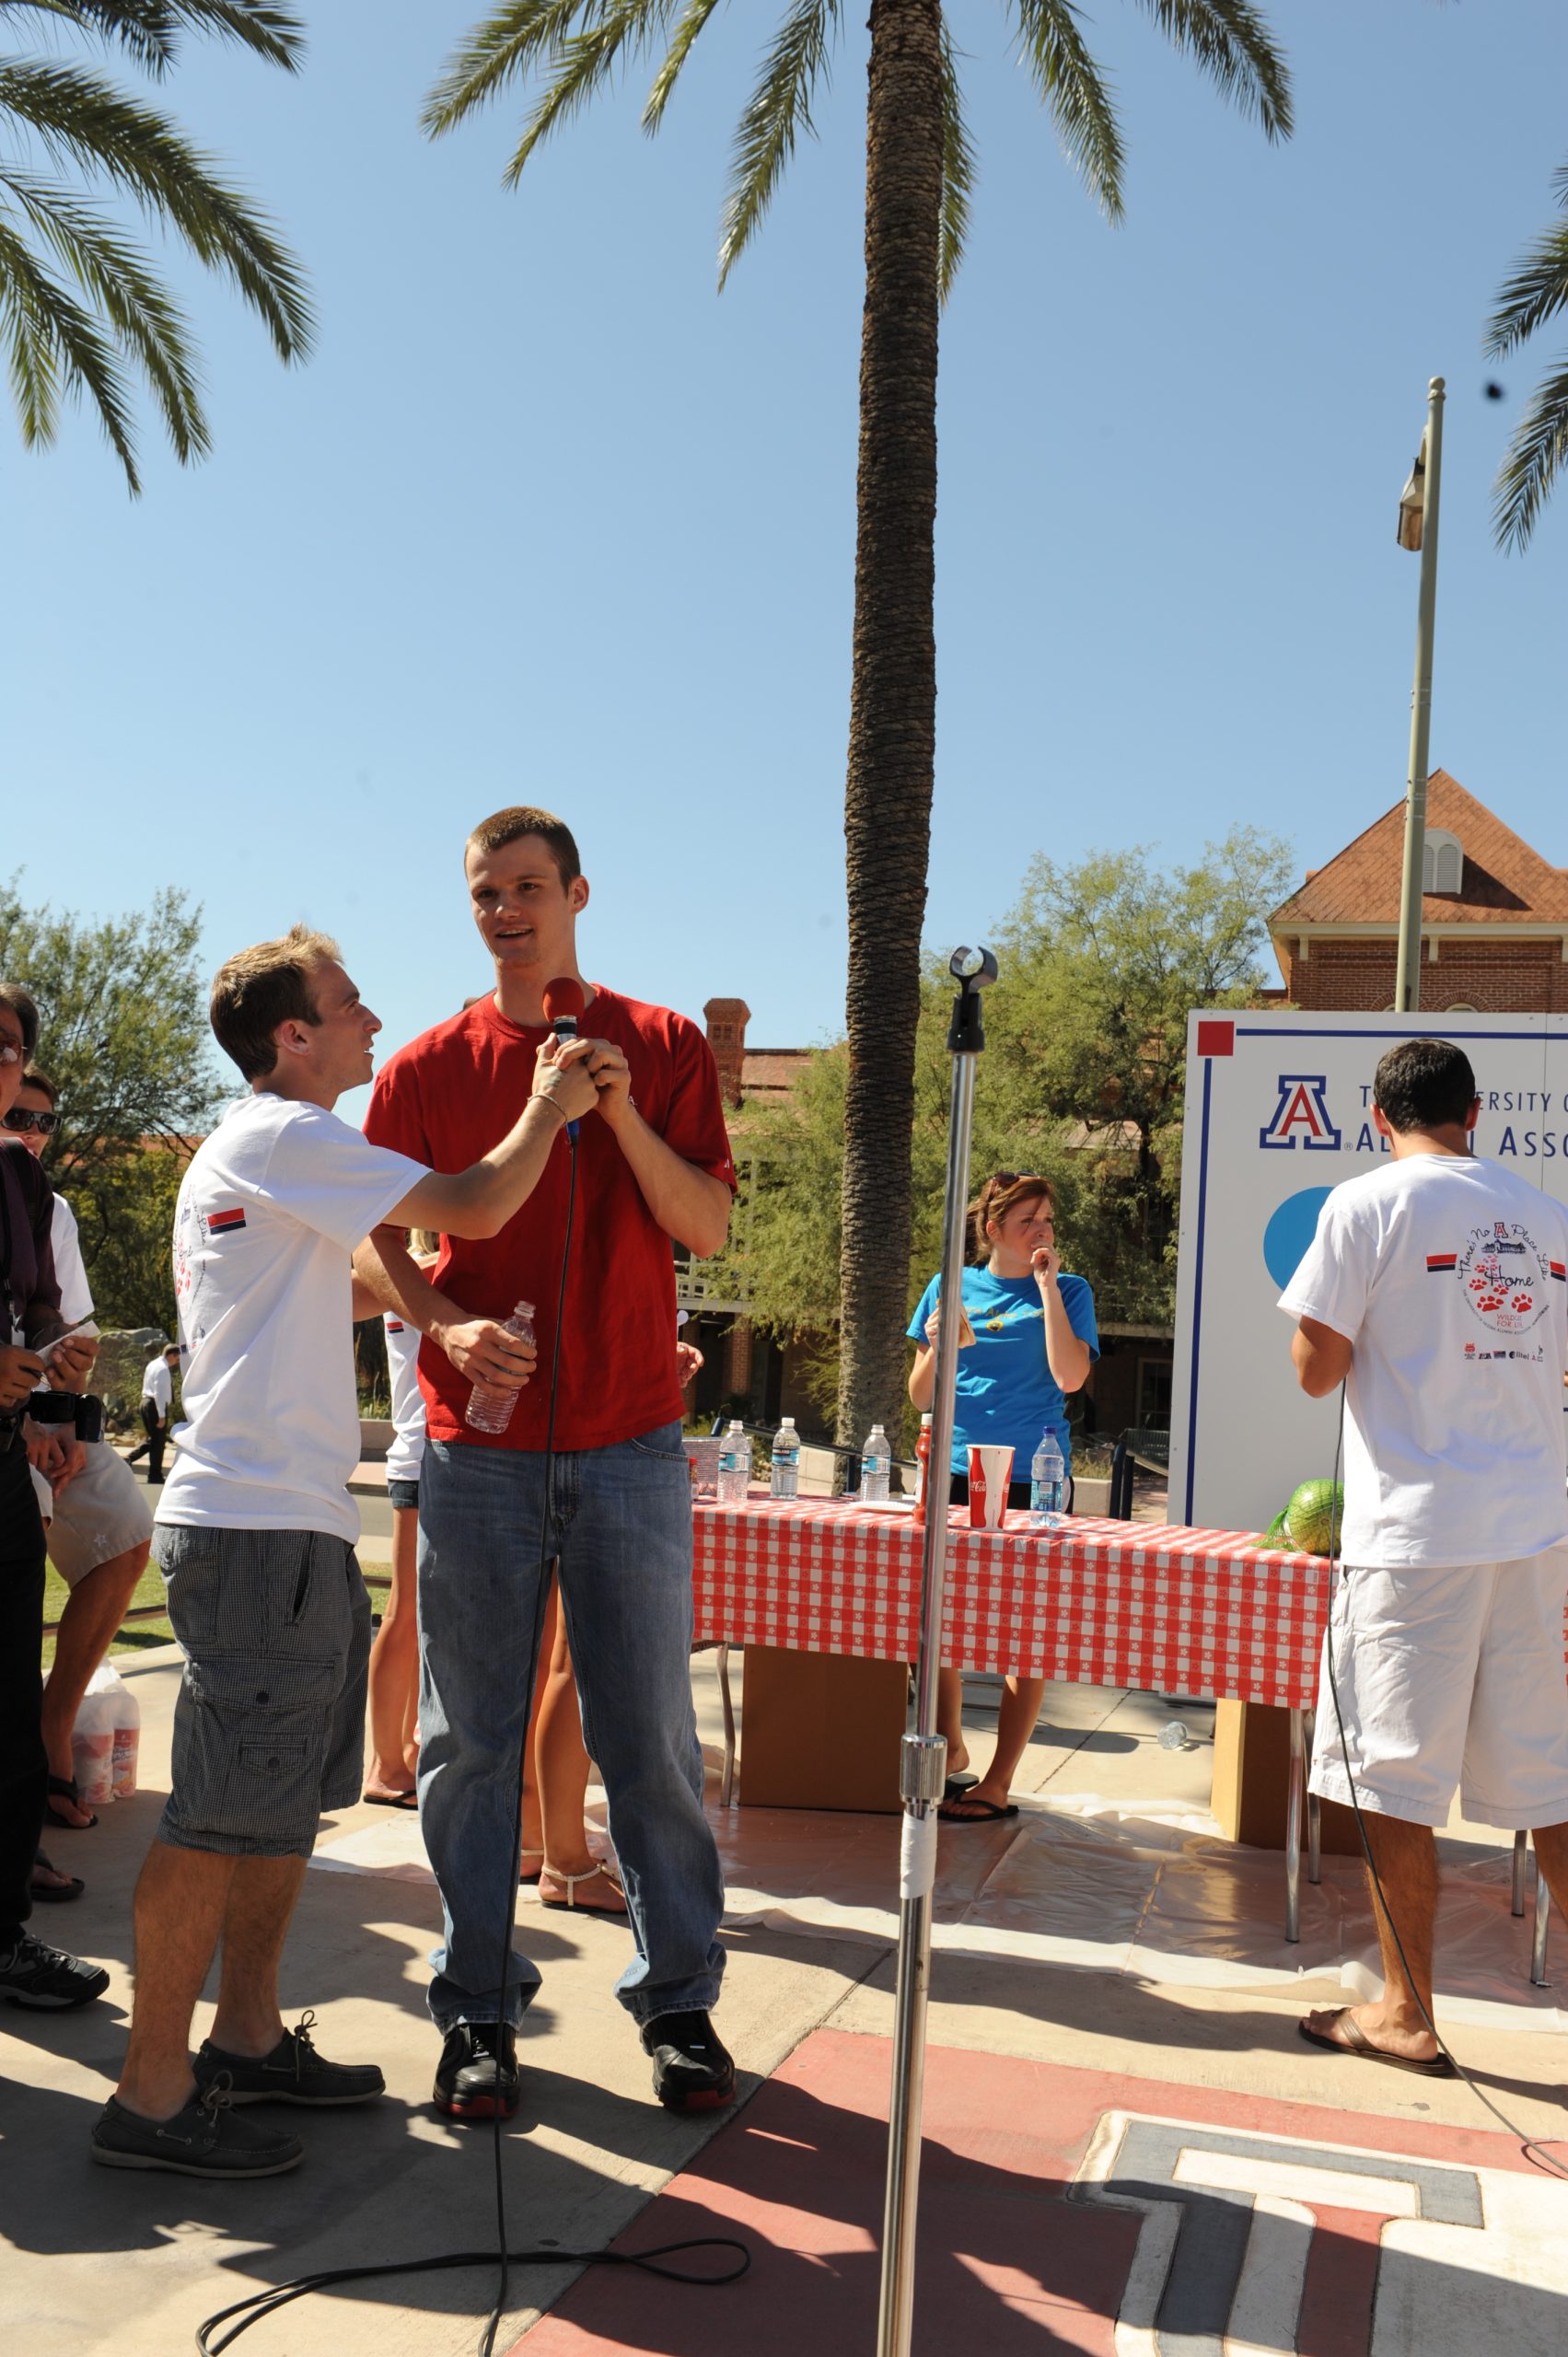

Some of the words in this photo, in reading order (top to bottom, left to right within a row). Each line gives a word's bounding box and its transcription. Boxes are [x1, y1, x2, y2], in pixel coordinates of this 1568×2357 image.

[1475, 1090, 1551, 1112] ERSITY
[1498, 1126, 1568, 1157] ASS
[1511, 1224, 1538, 1252] Place
[1484, 1265, 1534, 1287] Home
